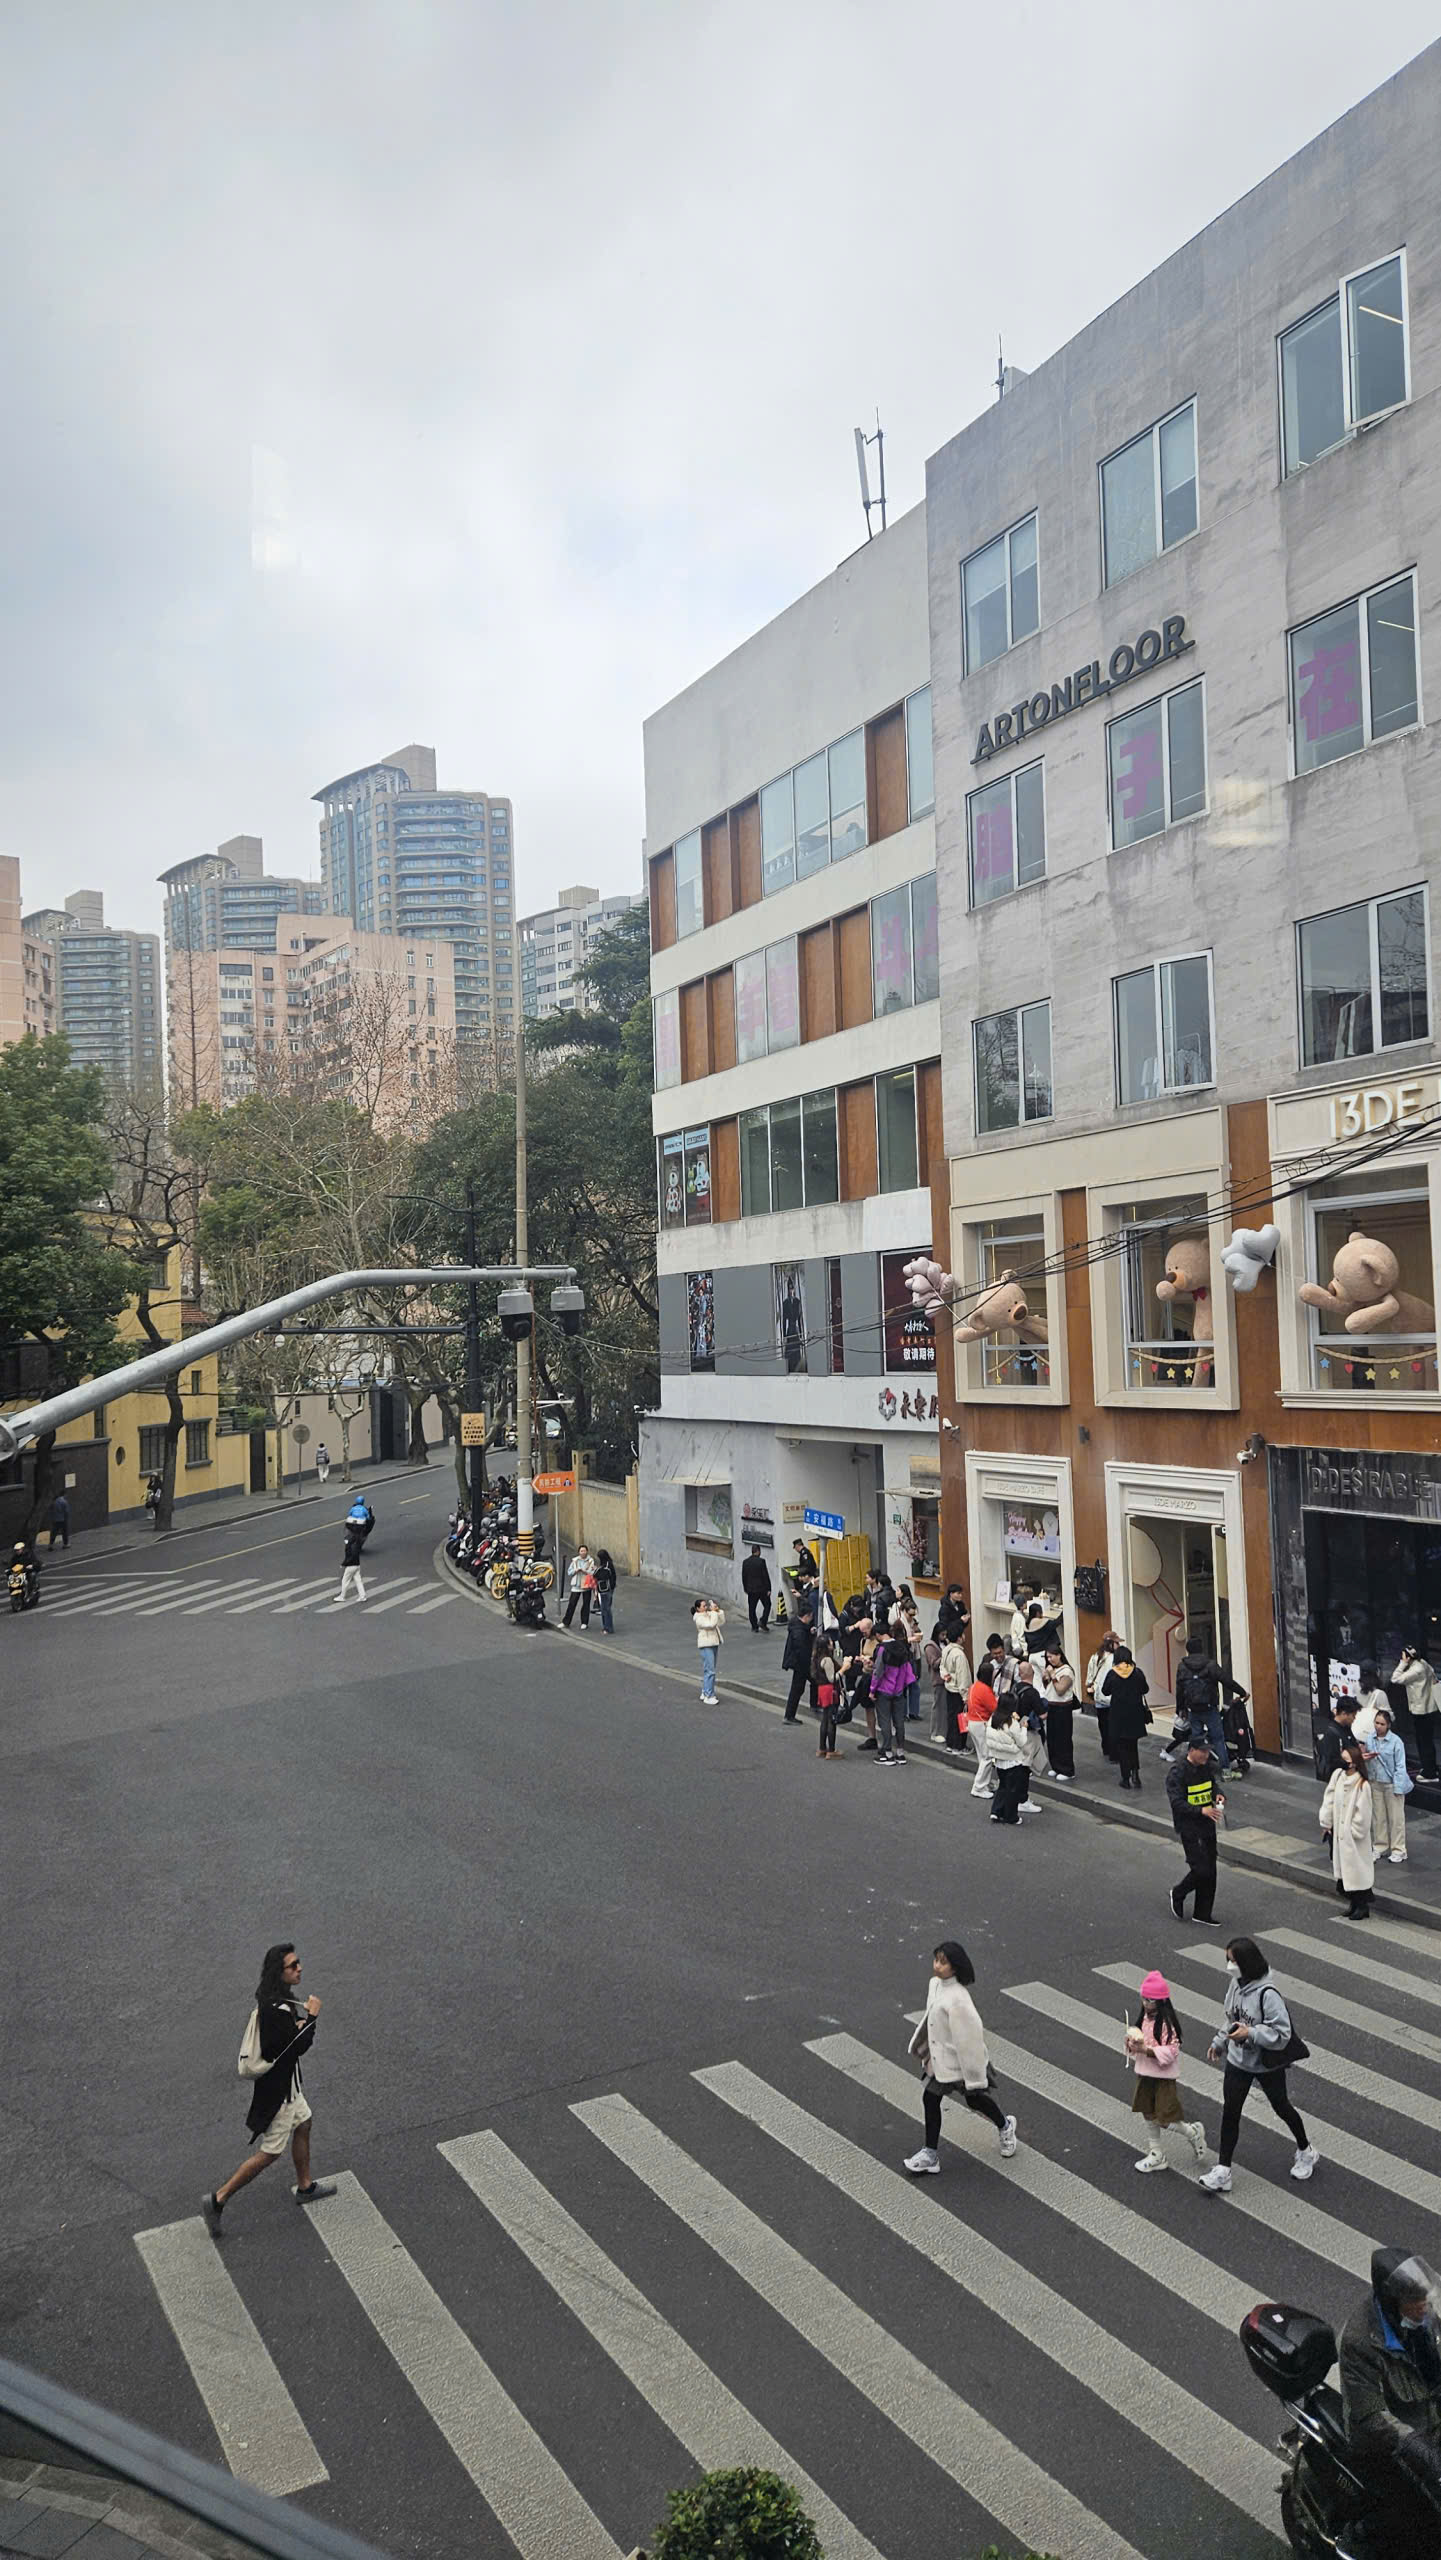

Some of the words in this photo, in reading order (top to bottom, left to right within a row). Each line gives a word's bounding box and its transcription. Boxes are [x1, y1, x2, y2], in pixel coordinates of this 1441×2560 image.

[973, 615, 1190, 762] ARTONFLOOR
[903, 1347, 935, 1361] 敬请期待
[813, 1513, 834, 1528] 安福路
